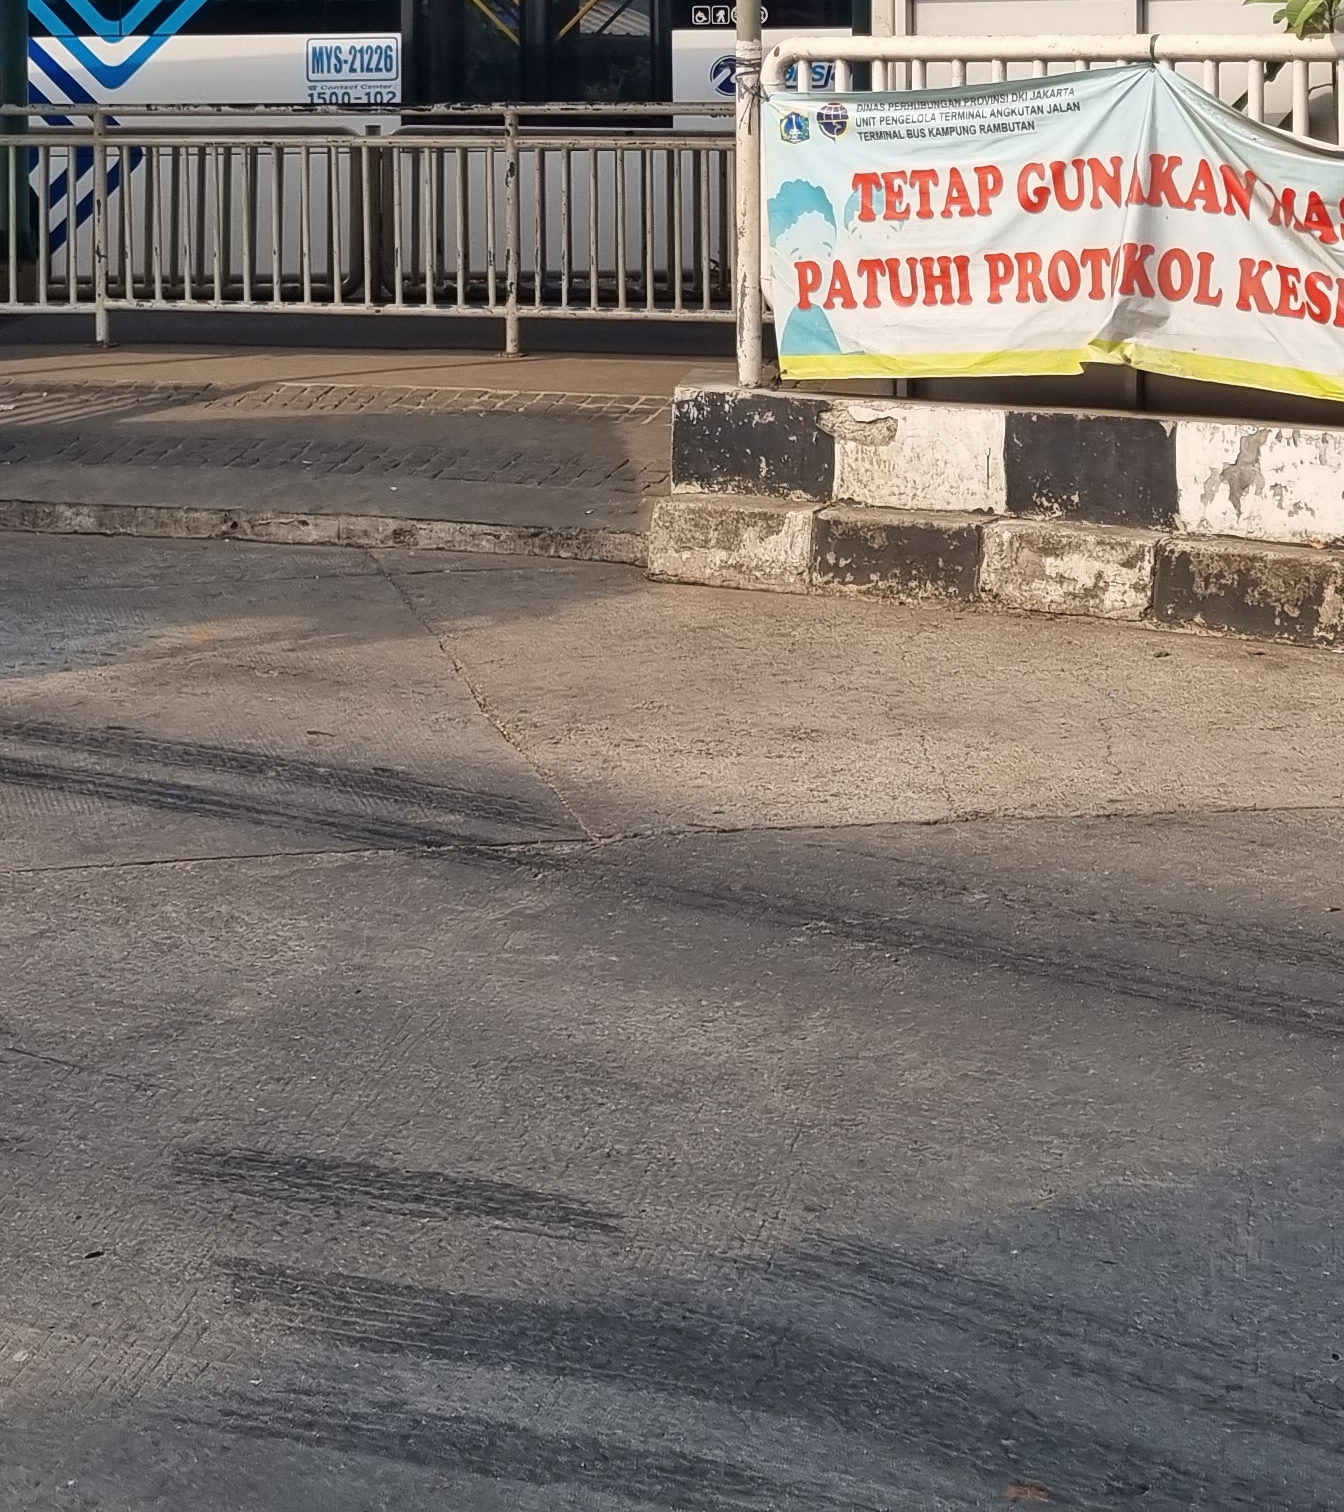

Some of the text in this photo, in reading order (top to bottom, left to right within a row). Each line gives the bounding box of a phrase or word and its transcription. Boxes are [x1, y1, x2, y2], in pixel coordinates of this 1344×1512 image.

[311, 44, 394, 75] MYS-21226
[855, 101, 1081, 128] UNIT PENGELOLA TERMINAL ANGKUTAN JALAN
[857, 88, 1075, 113] DINAS PERHUBUNGAN PROVINSI DKI JAKARTA
[857, 120, 1036, 142] TERMINAL BUS KAMPUNG RAMBUTAN
[852, 164, 1004, 223] TETAP
[794, 255, 973, 310] PATUHI
